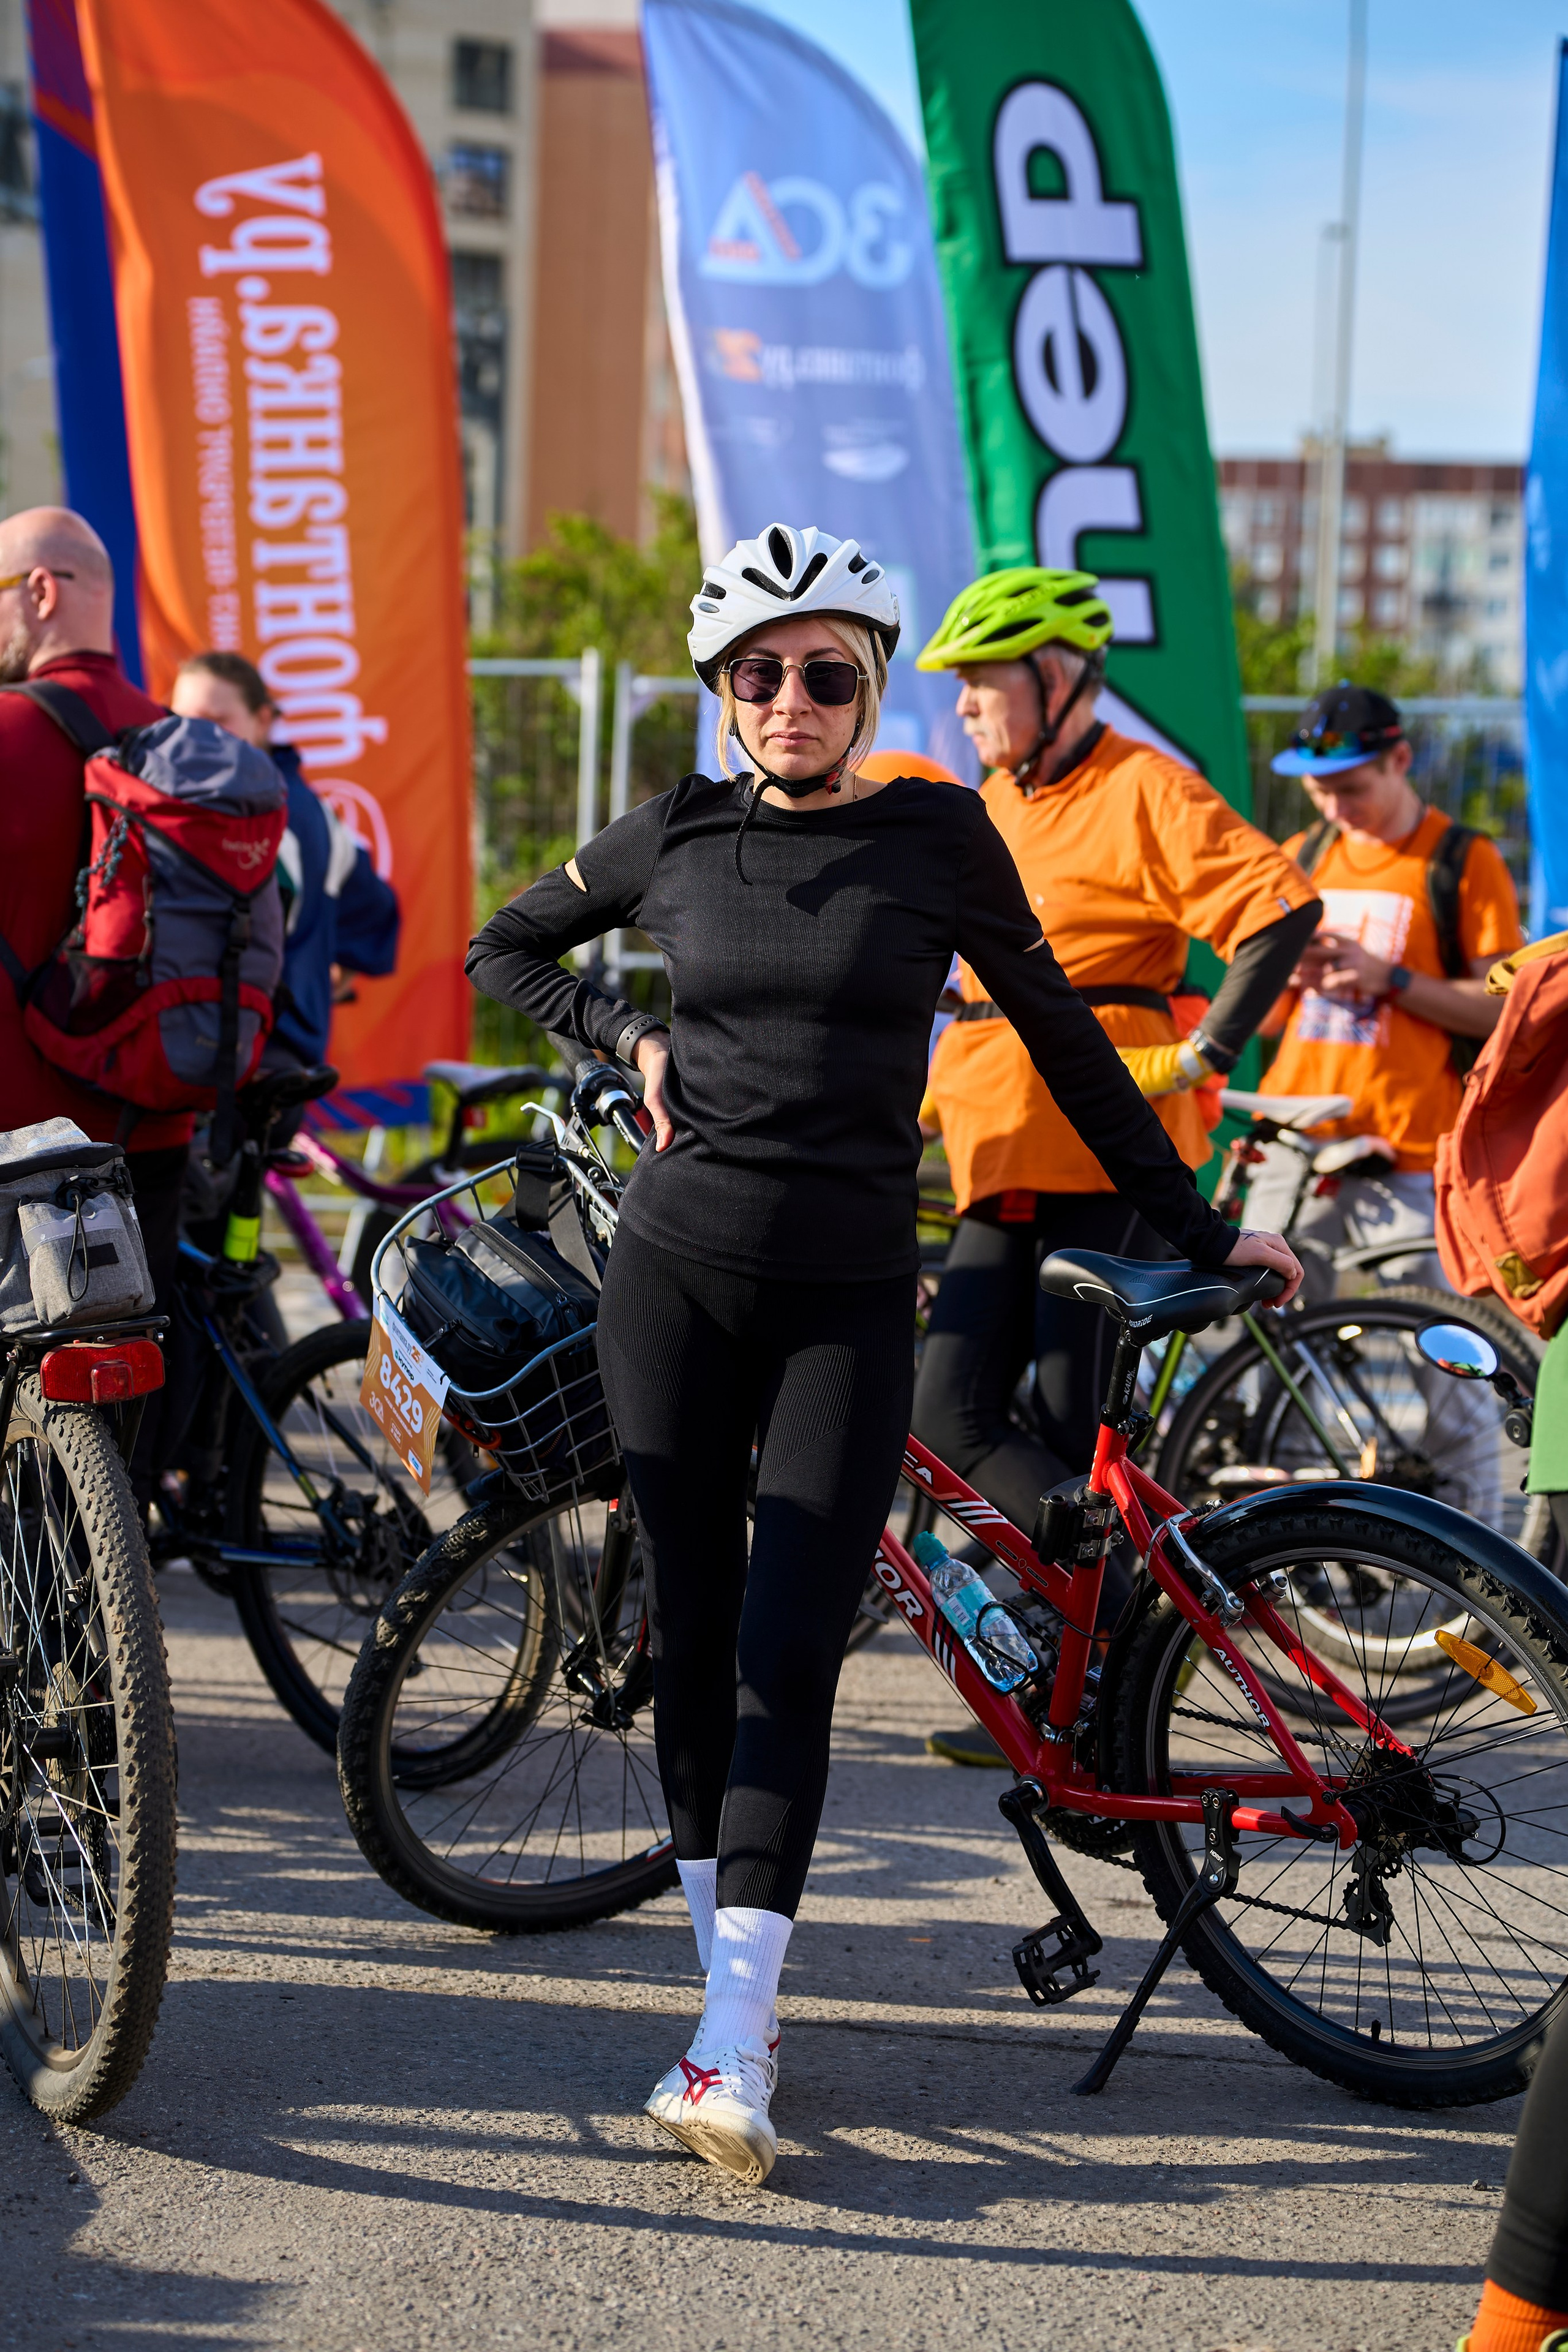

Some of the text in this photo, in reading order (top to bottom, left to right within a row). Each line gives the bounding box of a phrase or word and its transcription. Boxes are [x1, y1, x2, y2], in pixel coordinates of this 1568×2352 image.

[995, 83, 1199, 769] пер
[379, 1354, 423, 1434] 8429
[875, 1548, 924, 1620] OR
[1213, 1647, 1271, 1728] AUTHOR
[1209, 1849, 1224, 1863] HORST
